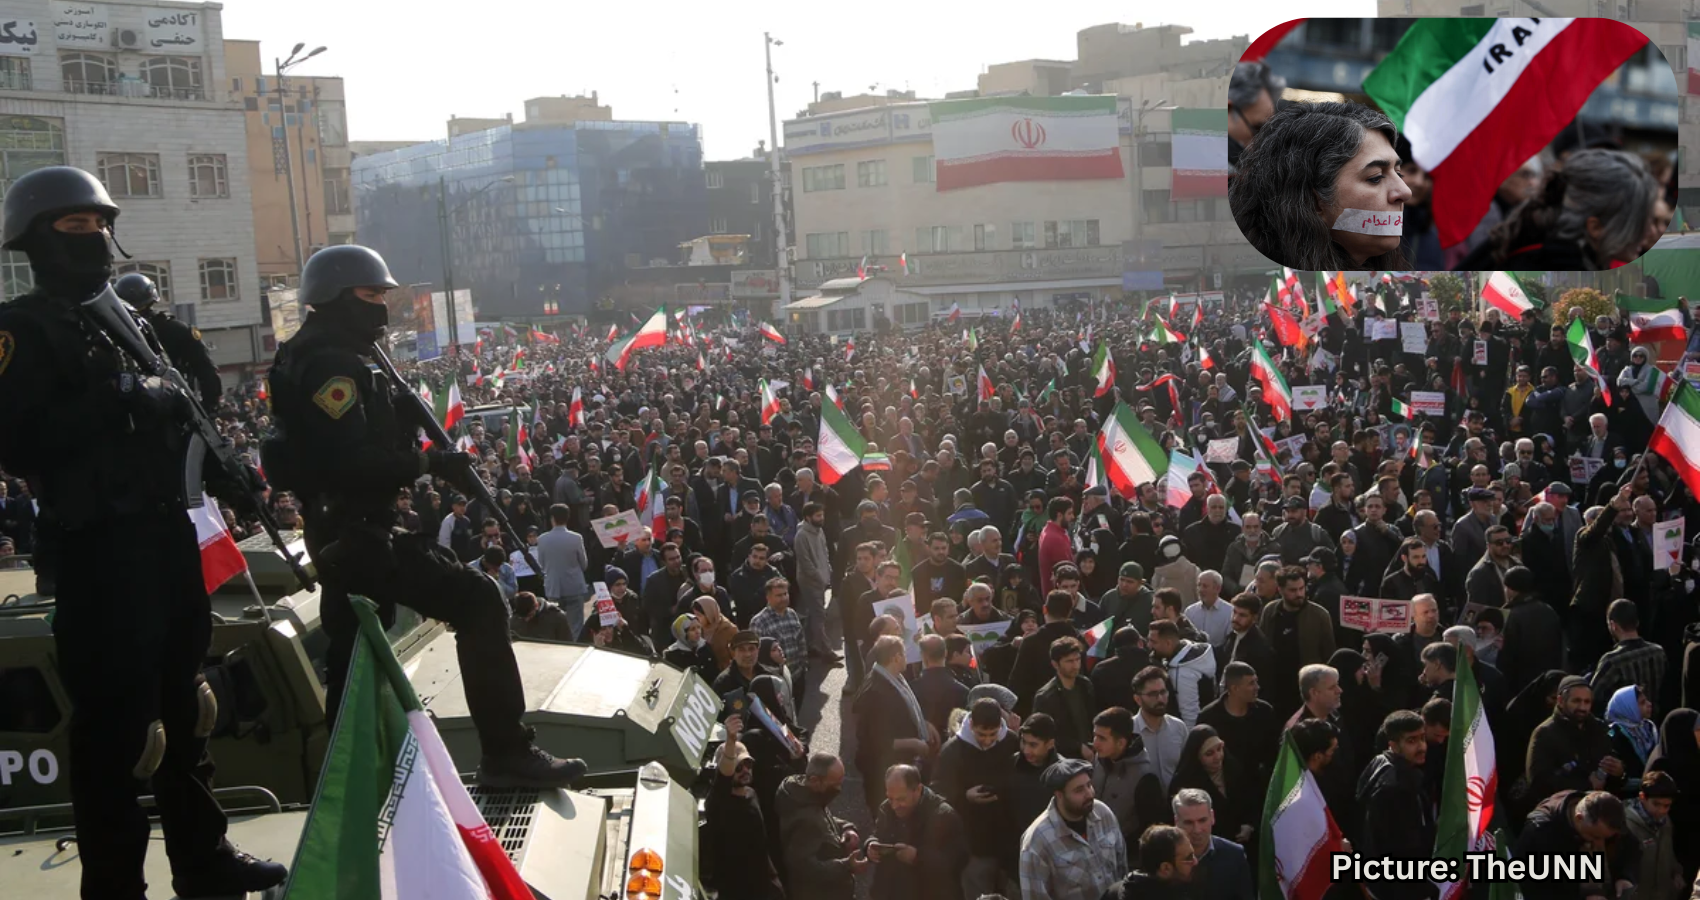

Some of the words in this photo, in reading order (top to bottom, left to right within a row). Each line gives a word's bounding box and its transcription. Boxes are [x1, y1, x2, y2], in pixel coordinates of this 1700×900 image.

[149, 12, 197, 28] آکادمی
[0, 20, 37, 52] نیک
[151, 32, 196, 47] حنفی
[1483, 17, 1541, 74] IRA
[1362, 215, 1391, 229] اعدام
[675, 682, 717, 759] NOPO
